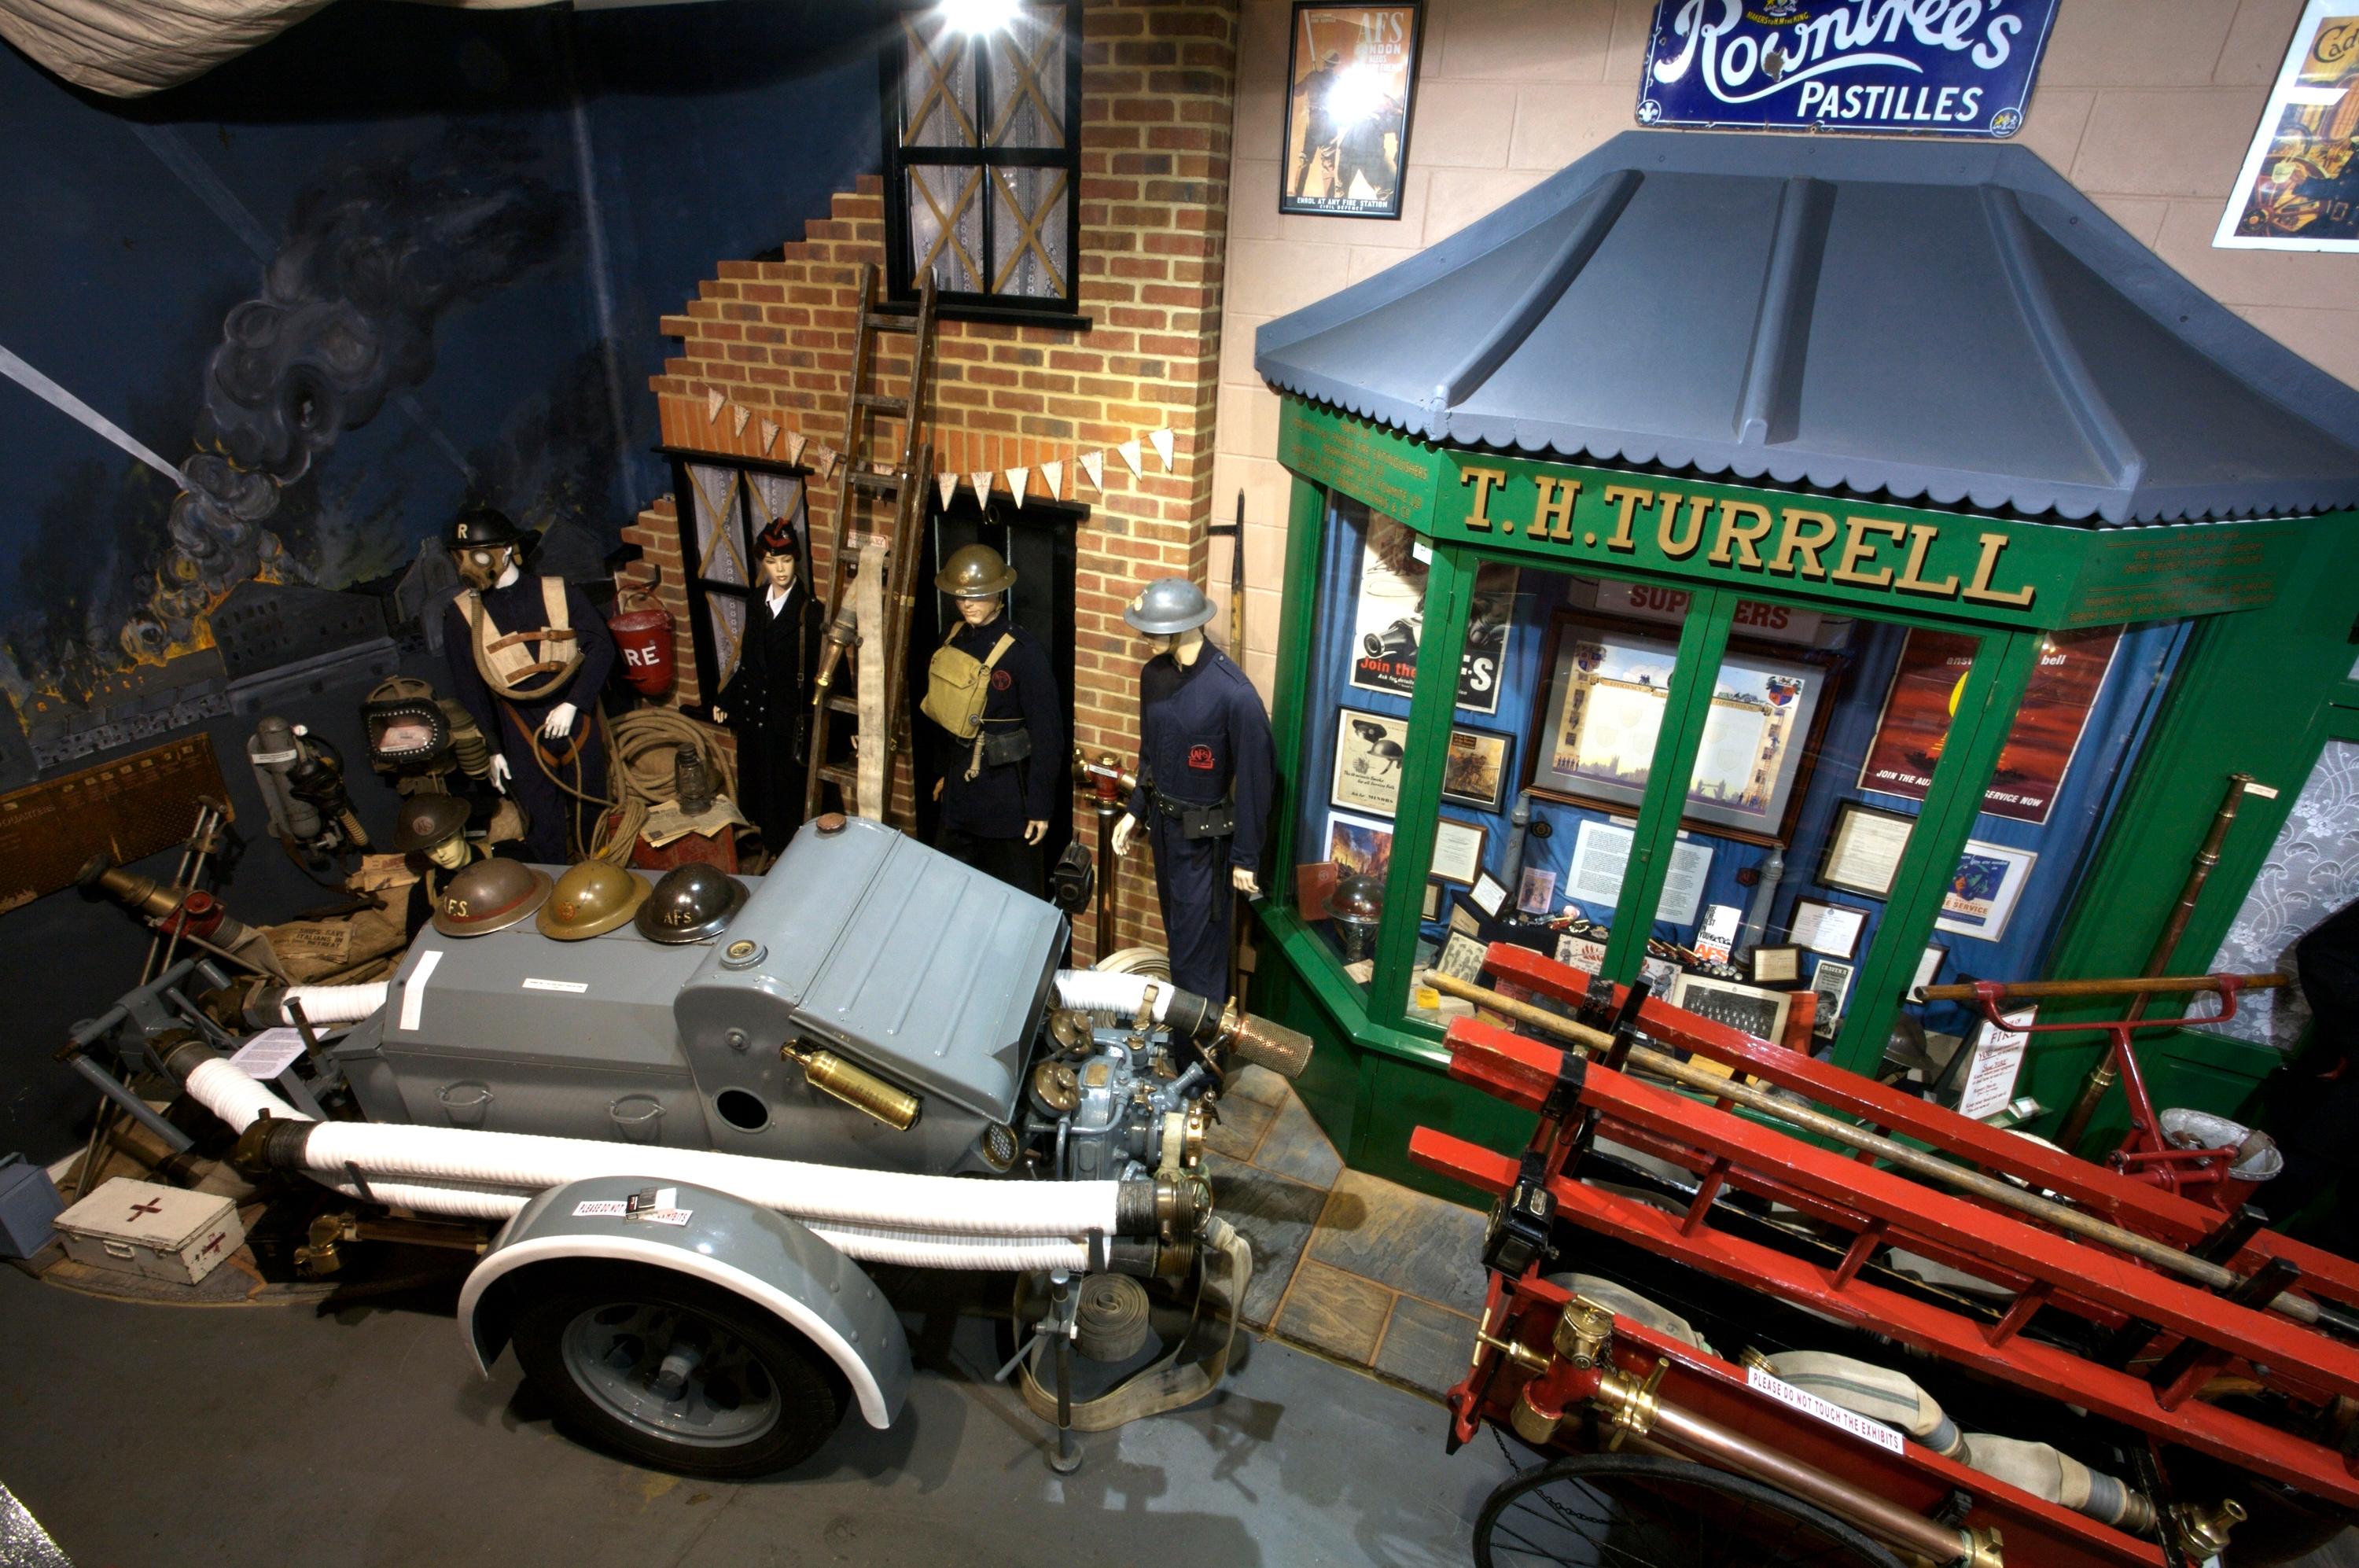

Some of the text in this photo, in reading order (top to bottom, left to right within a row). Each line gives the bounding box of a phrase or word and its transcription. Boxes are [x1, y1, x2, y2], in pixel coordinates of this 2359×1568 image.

[1356, 12, 1404, 43] AFS
[1797, 81, 1983, 122] PASTILLES
[458, 524, 468, 539] R
[624, 646, 660, 667] RE
[2041, 655, 2066, 665] bell
[1360, 656, 1416, 677] Join the
[1876, 769, 1897, 782] JOIN
[1898, 773, 1916, 784] THE
[1984, 790, 2043, 808] SERVICE NOW
[1953, 901, 1989, 914] SERVICE
[664, 909, 692, 926] AFS
[296, 933, 333, 943] ITALIANS
[326, 929, 346, 937] SAVE
[1694, 944, 1728, 964] AFS
[580, 1203, 625, 1213] PLEASE DO NOT
[1754, 1373, 1899, 1448] PLEASE DO NOT TOUCH THE EXHIBITS
